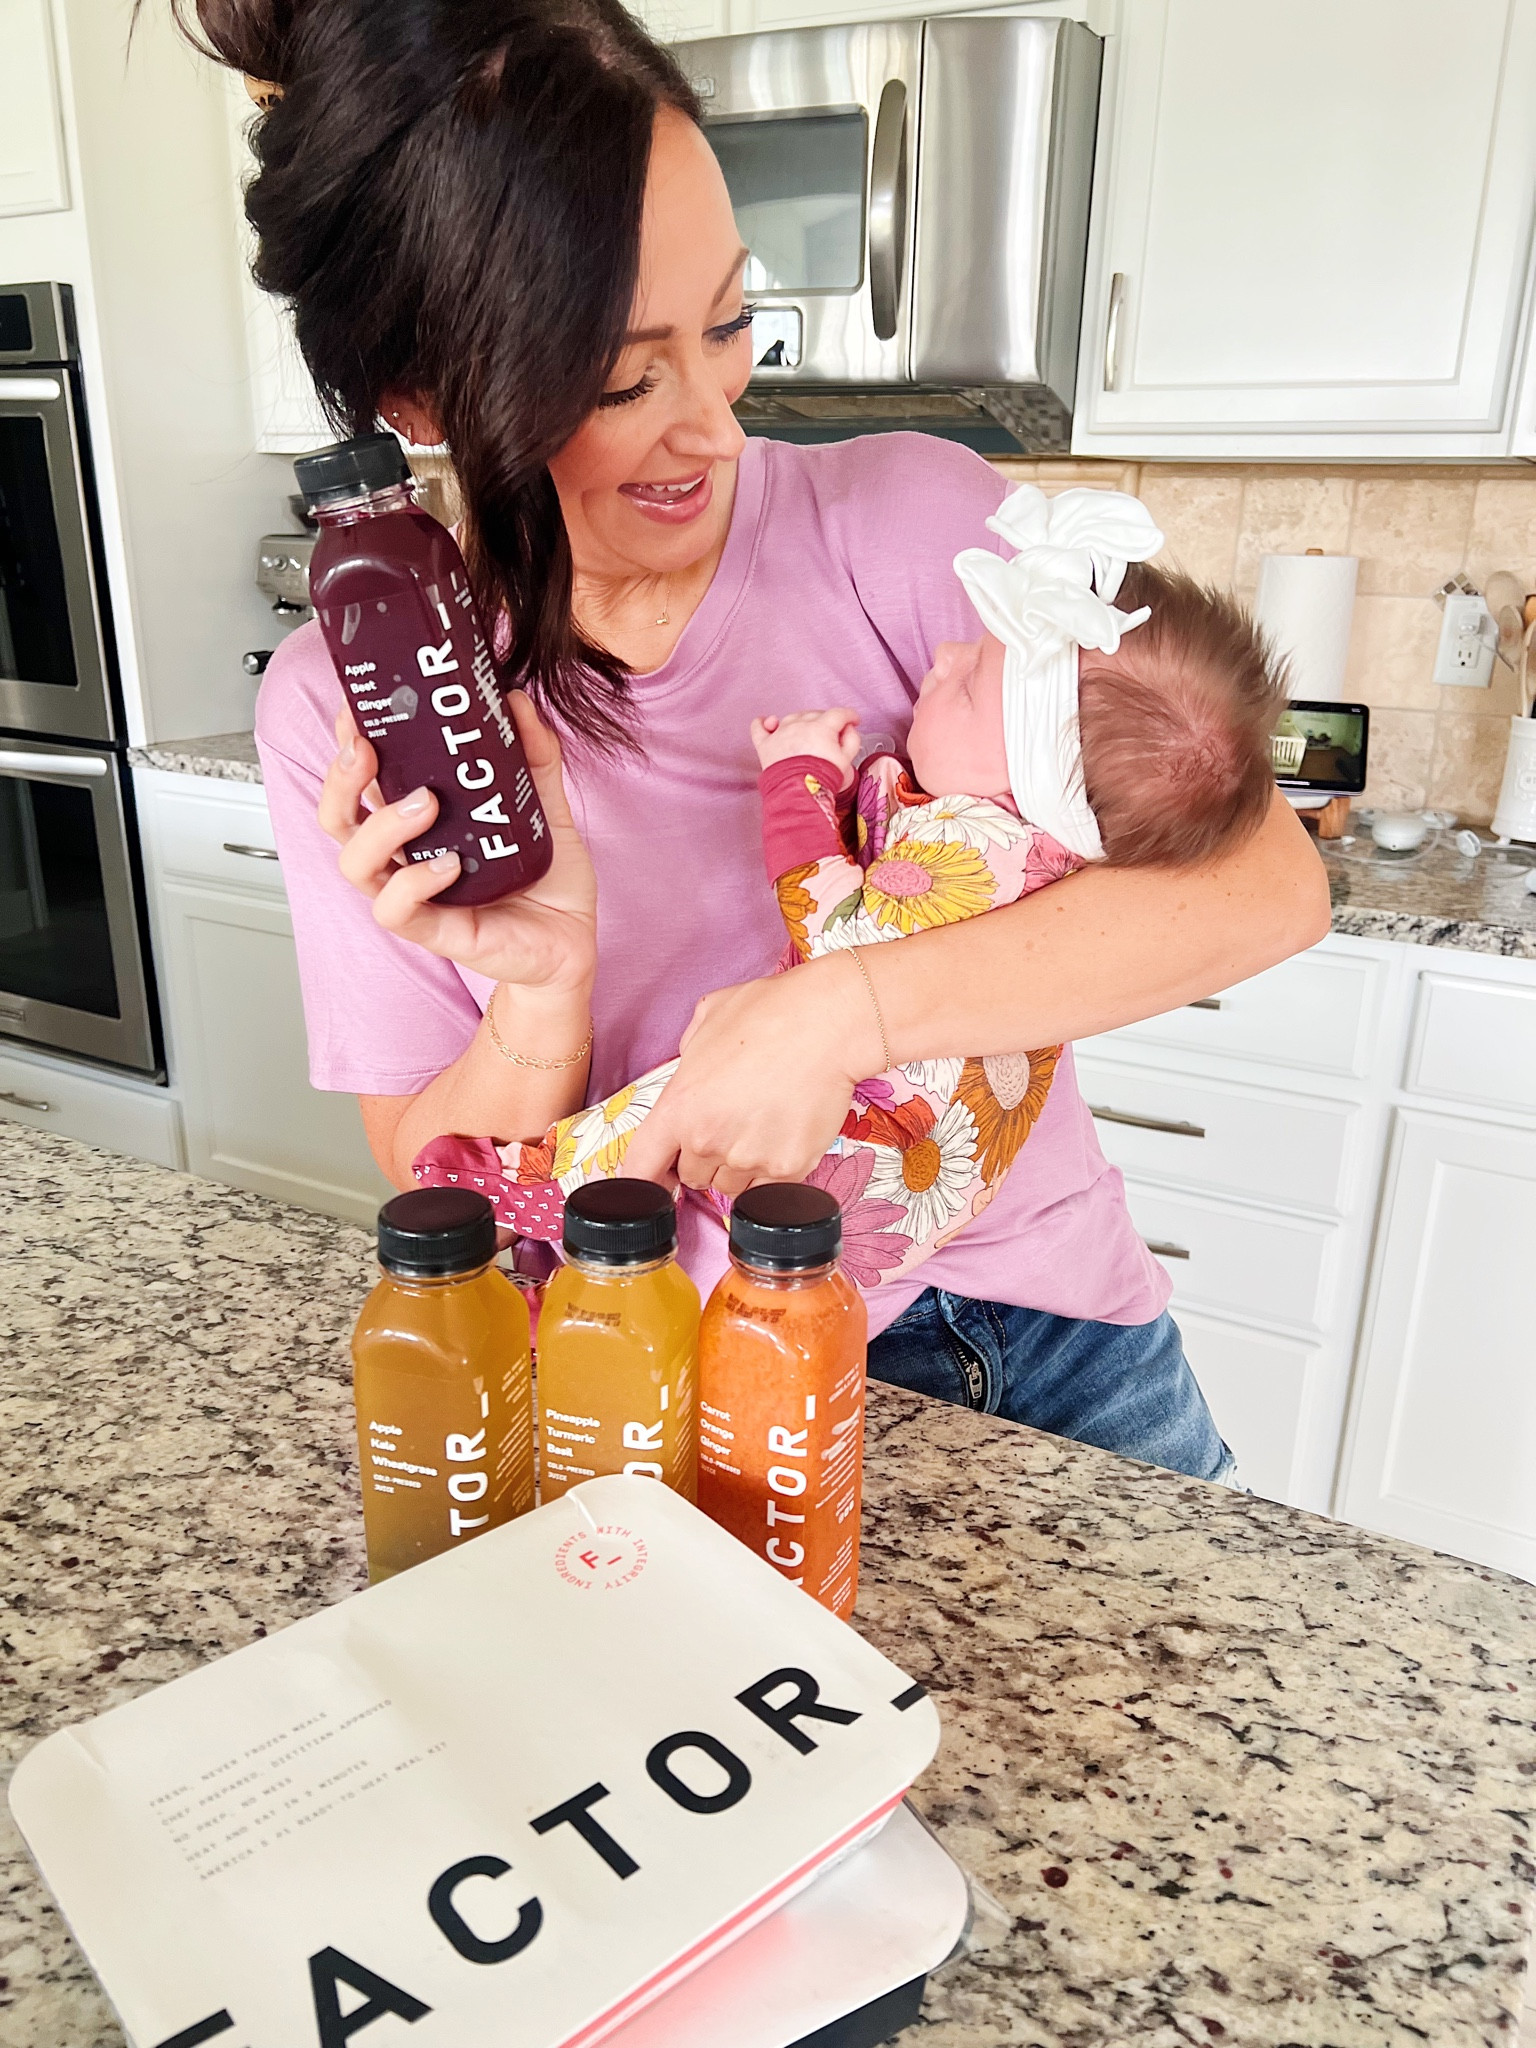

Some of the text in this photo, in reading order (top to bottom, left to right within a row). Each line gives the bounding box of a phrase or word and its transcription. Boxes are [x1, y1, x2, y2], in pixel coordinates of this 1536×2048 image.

[344, 661, 377, 676] Apple
[350, 680, 377, 694] Beet
[357, 696, 393, 713] Ginger
[422, 851, 434, 859] FL
[546, 1408, 600, 1428] Pineapple
[700, 1400, 731, 1422] Carrot
[369, 1421, 402, 1436] Apple
[546, 1426, 596, 1444] Turmeric
[700, 1418, 734, 1440] Orange
[370, 1438, 396, 1452] Kale
[546, 1443, 573, 1458] Basil
[700, 1435, 732, 1456] Ginger
[372, 1455, 438, 1477] Wheatgrass
[547, 1461, 595, 1476] COLD-PRESSED
[373, 1474, 421, 1489] COLD-PRESSED
[555, 1526, 647, 1590] INGREDIENTS WITH INTEGRITY
[200, 1758, 239, 1781] NEVER
[244, 1733, 288, 1759] FROZEN
[291, 1711, 328, 1733] MEALS
[161, 1807, 190, 1826] CHEF
[270, 1731, 335, 1769] DIETITIAN
[339, 1699, 392, 1731] APPROVED
[394, 1755, 423, 1772] MEAL
[427, 1741, 447, 1755] KIT
[172, 1832, 189, 1844] NO
[240, 1796, 257, 1809] NO
[261, 1777, 292, 1796] MESS
[185, 1842, 217, 1863] HEAT
[225, 1825, 248, 1842] AND
[253, 1809, 276, 1825] EAT
[283, 1798, 300, 1809] IN
[317, 1759, 368, 1790] MINUTES
